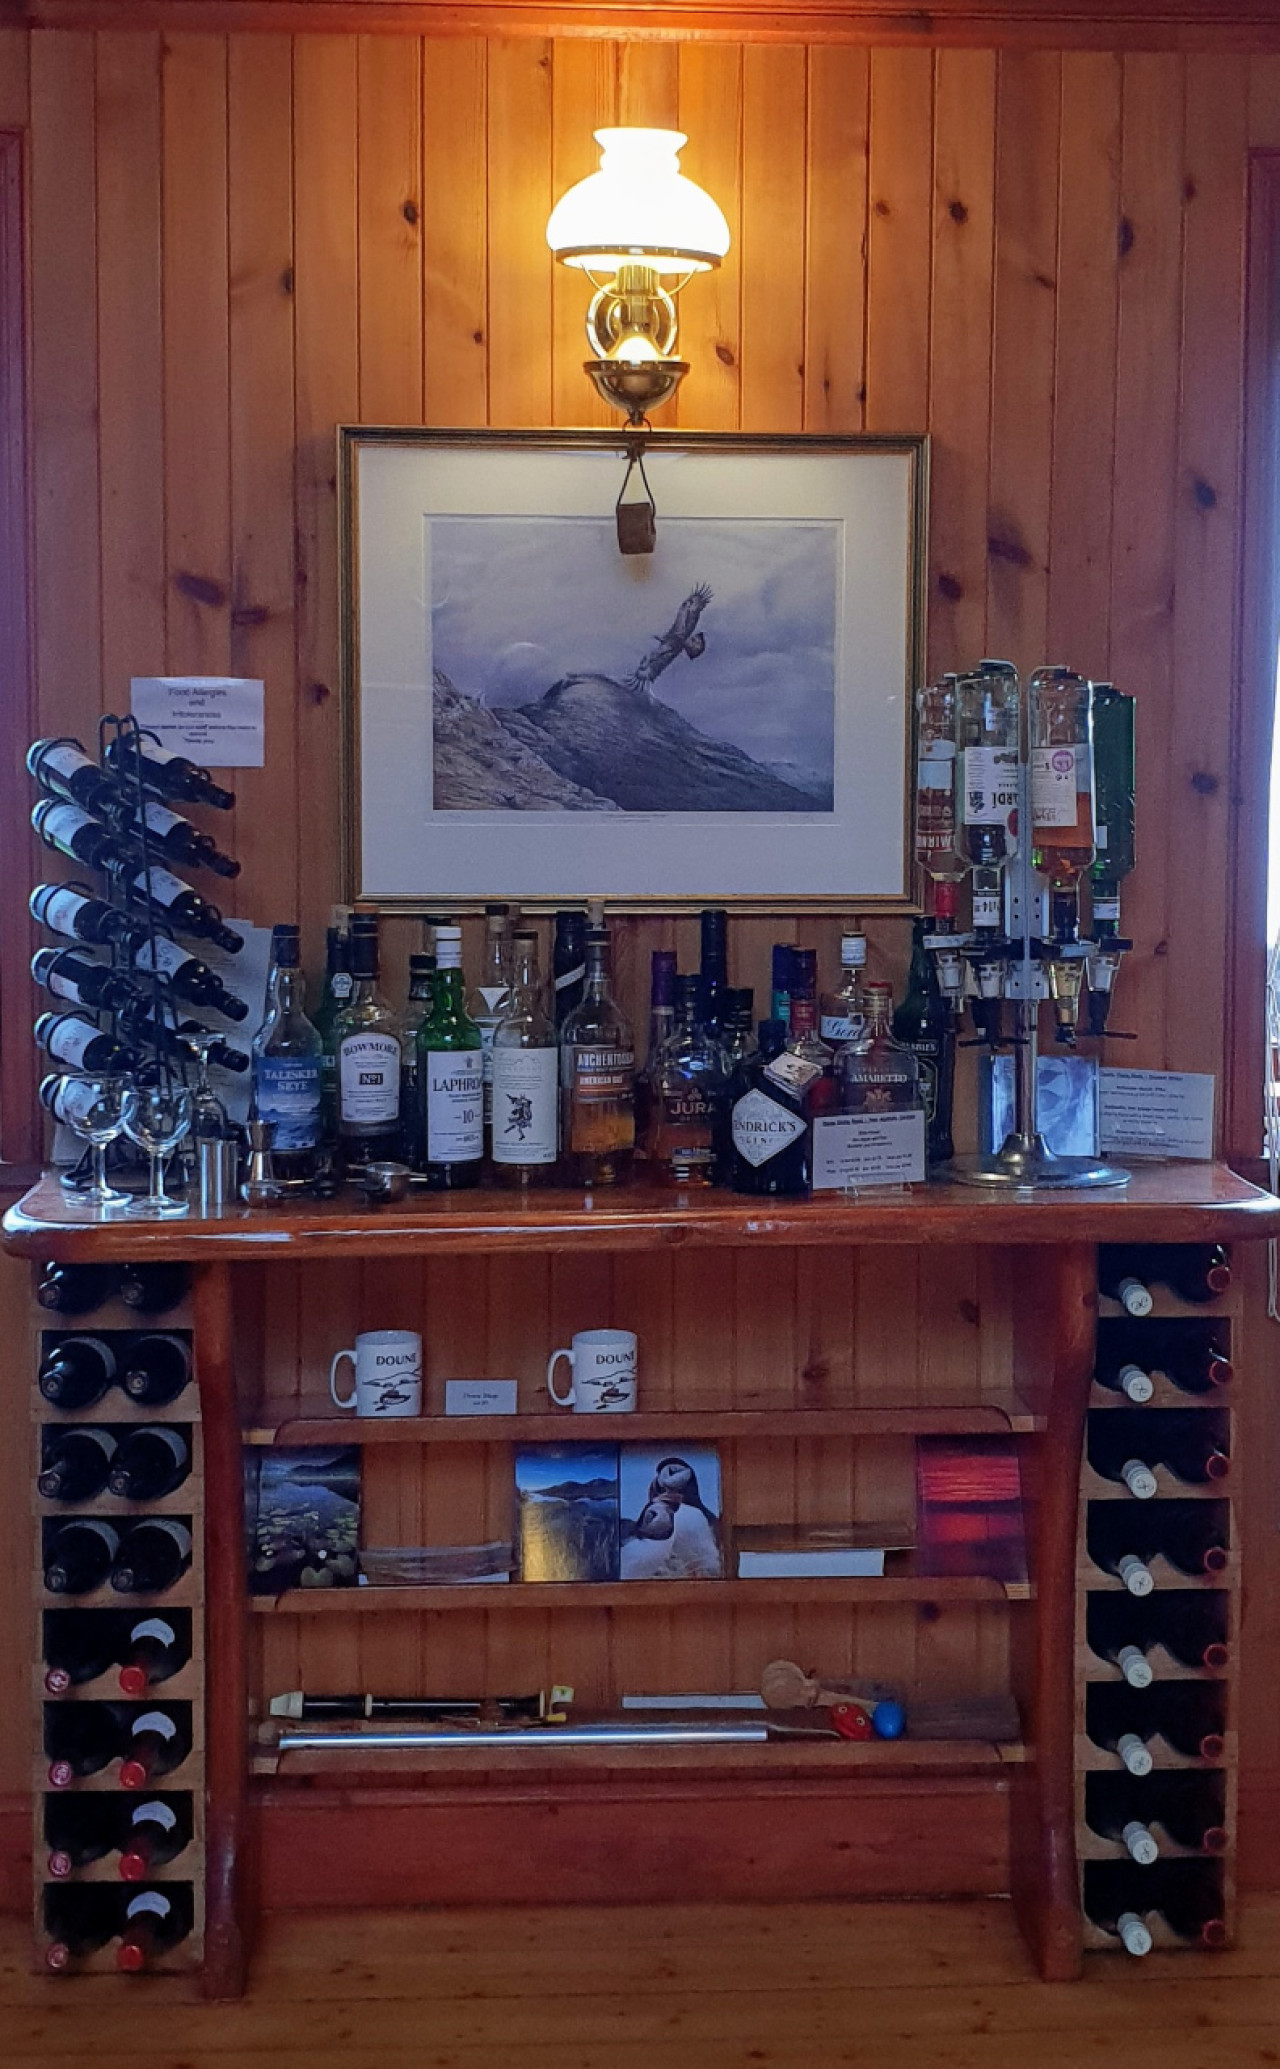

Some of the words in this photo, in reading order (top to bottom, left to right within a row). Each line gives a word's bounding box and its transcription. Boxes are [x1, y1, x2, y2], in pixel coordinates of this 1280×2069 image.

[343, 1042, 398, 1056] BOWMORE
[264, 1069, 318, 1079] TALISKER
[277, 1081, 308, 1091] SKYE
[432, 1077, 482, 1092] LAPHRO
[670, 1101, 717, 1115] JURA
[463, 1108, 475, 1124] 10
[733, 1119, 796, 1132] ENDRICK'S
